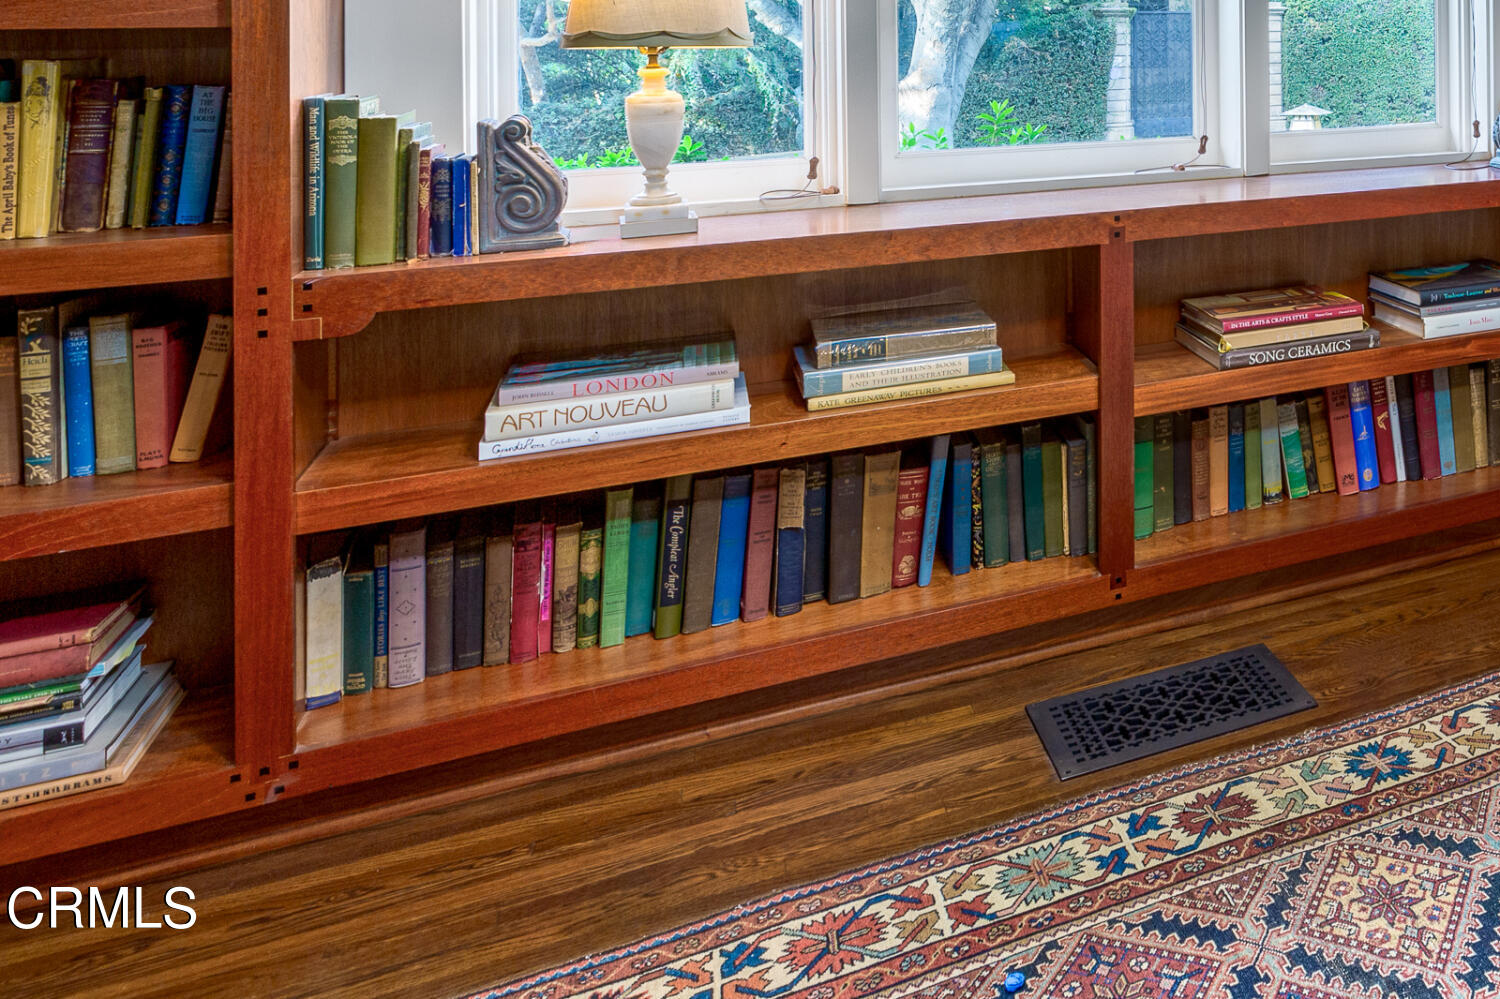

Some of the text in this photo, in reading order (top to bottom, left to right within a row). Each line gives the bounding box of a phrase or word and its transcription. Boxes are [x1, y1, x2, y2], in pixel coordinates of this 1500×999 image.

[309, 107, 320, 124] Man
[309, 125, 320, 140] and
[309, 141, 320, 173] Wildlife
[1, 105, 17, 233] The April Baby's Book of Tunes
[309, 175, 320, 185] in
[1250, 318, 1266, 326] ARTS
[1271, 315, 1292, 324] CRAFTS
[1292, 313, 1309, 321] STYLE
[1248, 338, 1351, 366] SONG CERAMICS
[572, 371, 674, 397] LONDON
[849, 381, 869, 389] AND
[817, 386, 942, 408] KATE GREENAWAY PICTURES
[500, 394, 668, 433] ART NOUVEAU
[664, 505, 685, 599] The Compleat Angler
[377, 570, 386, 587] BEST
[377, 590, 386, 608] LIKE
[377, 623, 386, 655] STORIES
